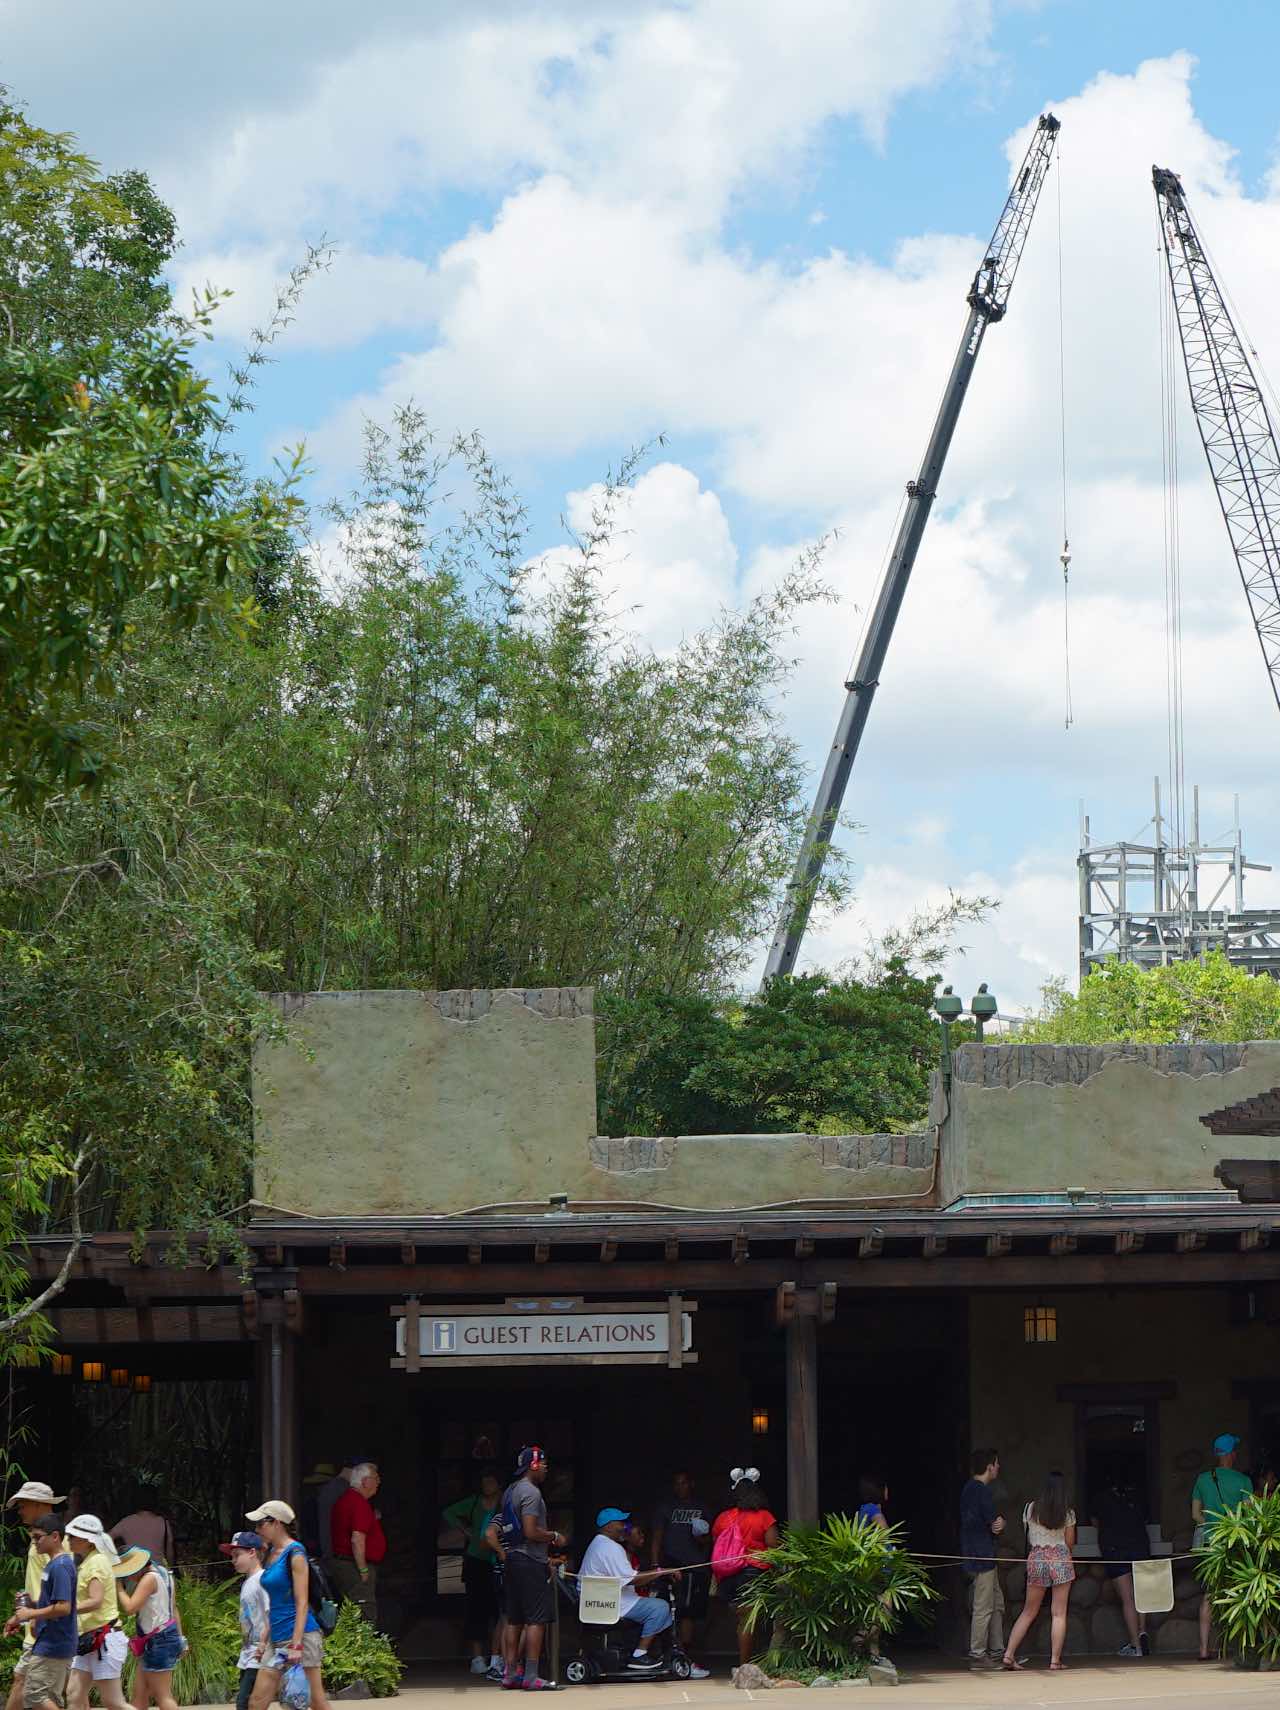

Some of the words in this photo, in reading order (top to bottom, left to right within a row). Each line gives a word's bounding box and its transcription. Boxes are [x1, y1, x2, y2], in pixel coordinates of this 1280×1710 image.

[464, 1326, 532, 1344] GUEST
[541, 1324, 656, 1344] RELATIONS
[585, 1600, 616, 1609] ENTRANCE
